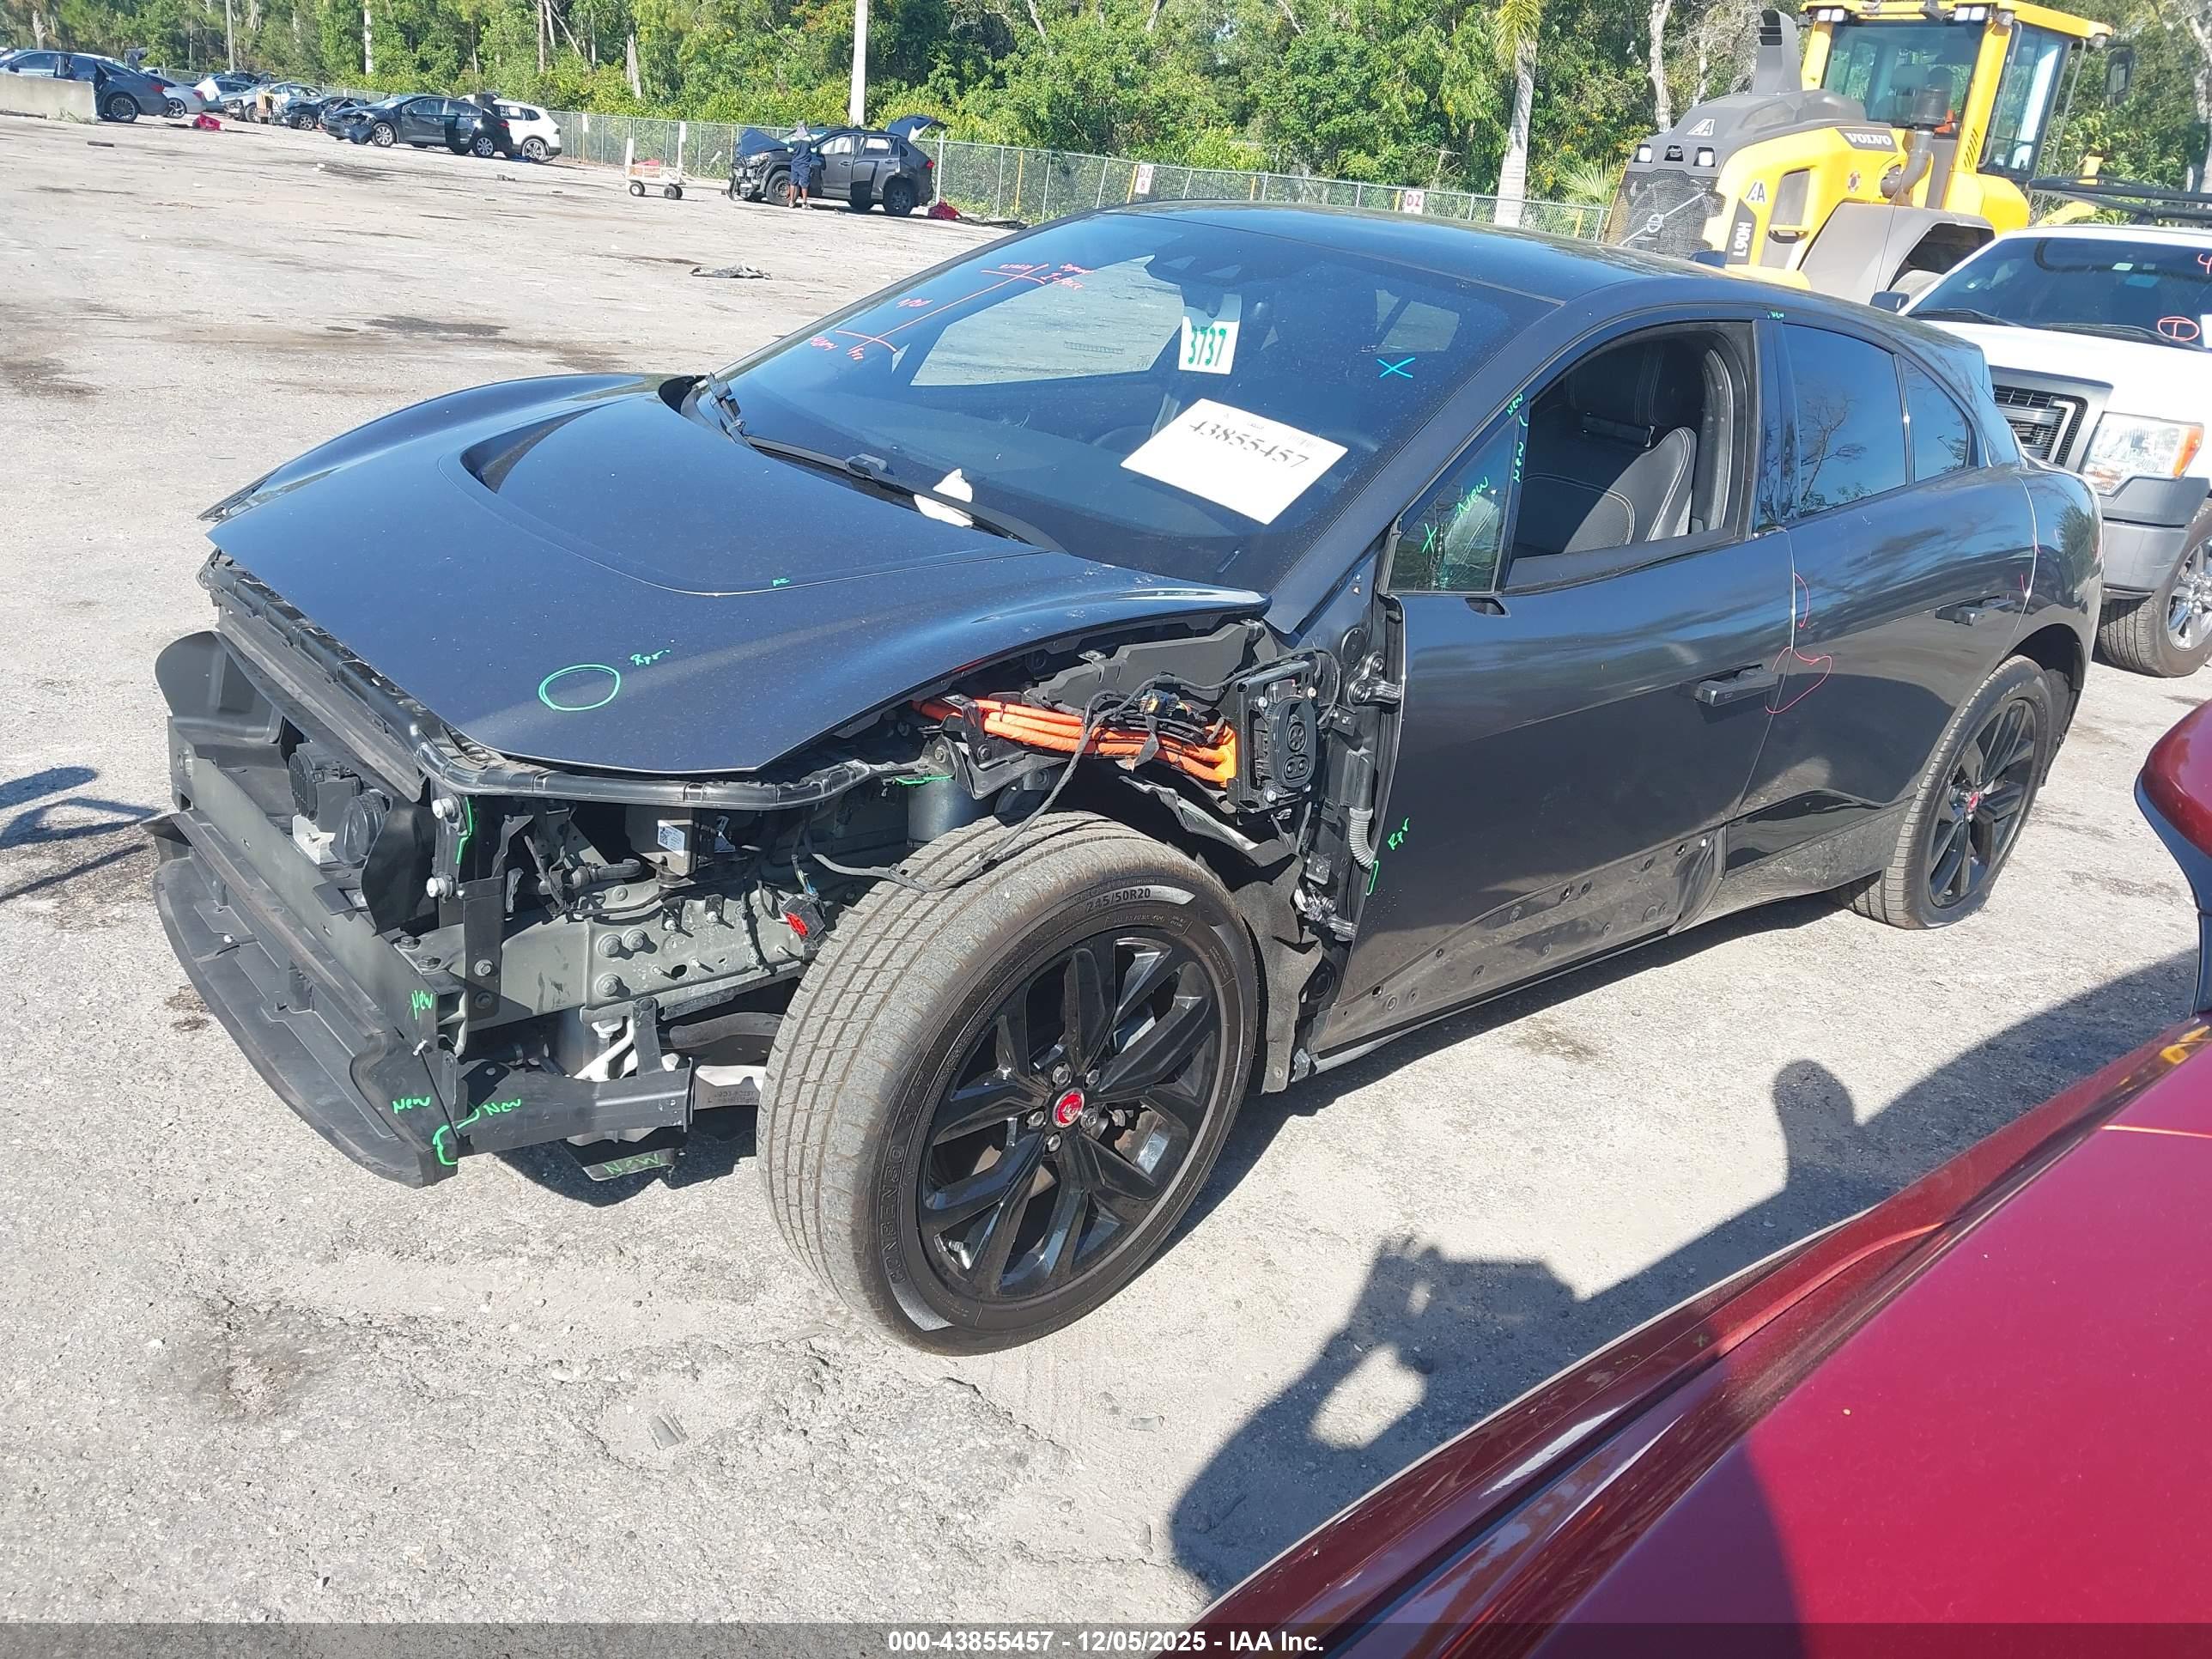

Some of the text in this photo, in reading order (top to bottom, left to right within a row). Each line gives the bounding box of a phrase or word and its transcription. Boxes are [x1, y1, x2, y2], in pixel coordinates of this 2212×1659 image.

[1844, 132, 1893, 146] VOLVO
[1733, 222, 1753, 257] L90H
[1188, 326, 1227, 367] 3737
[1188, 421, 1310, 468] 43855457
[1085, 887, 1152, 913] 245/50R20
